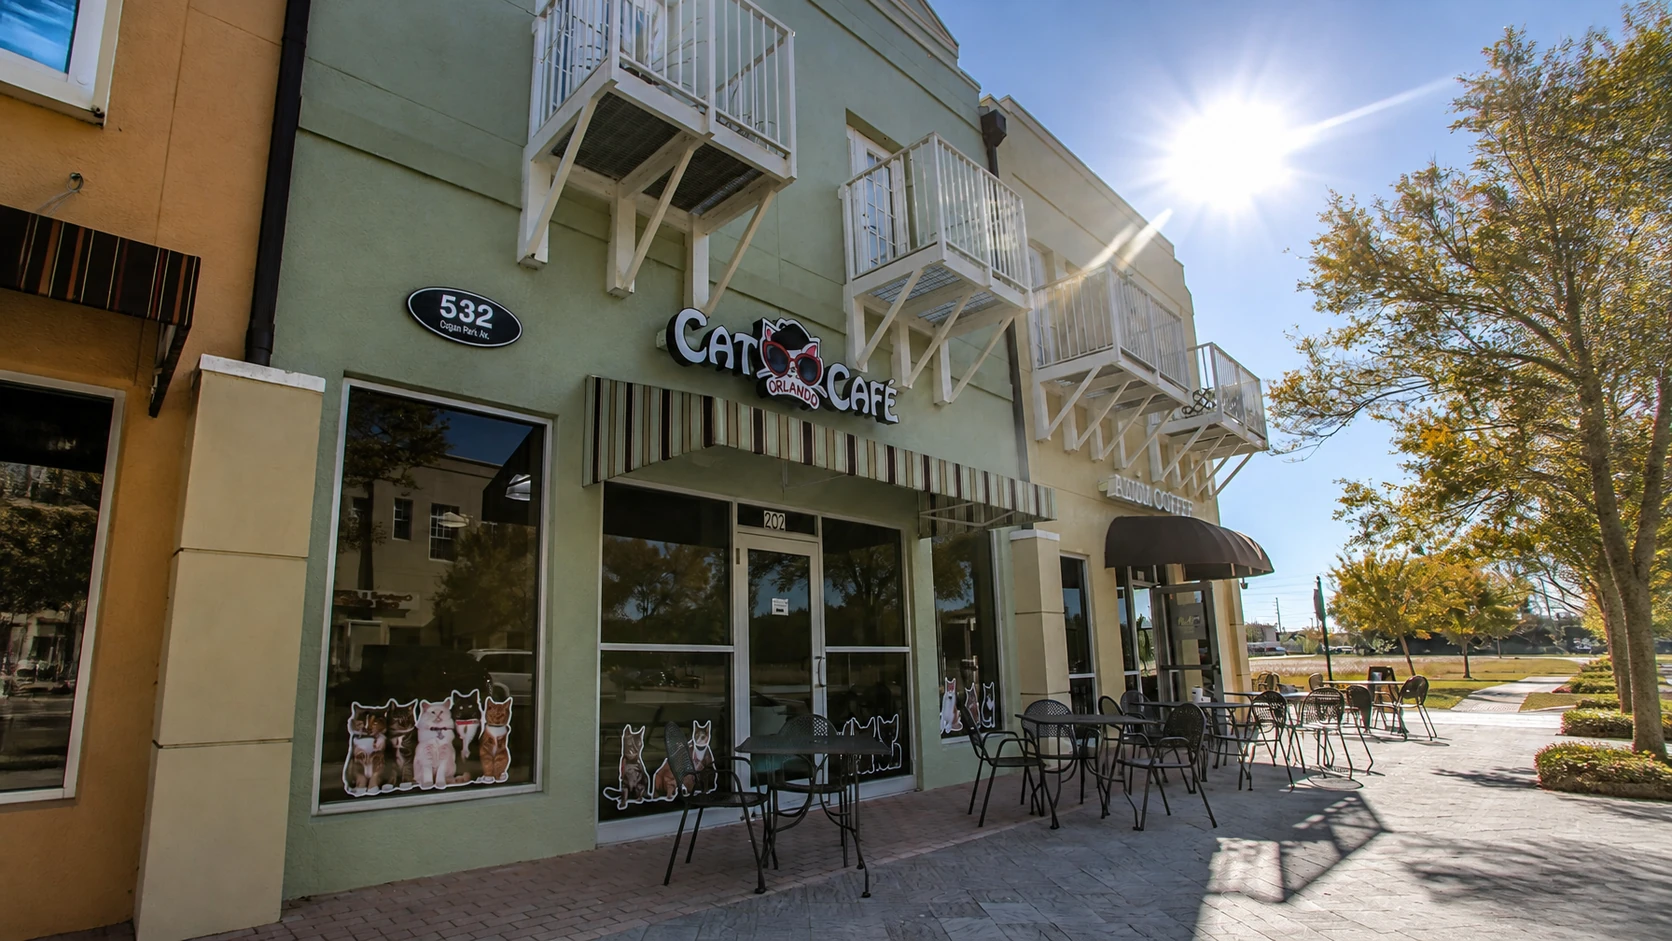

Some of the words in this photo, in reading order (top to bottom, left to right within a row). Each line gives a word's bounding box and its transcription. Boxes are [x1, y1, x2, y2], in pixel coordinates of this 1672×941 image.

[440, 294, 493, 329] 532
[673, 307, 759, 376] CAT
[826, 362, 899, 424] CAFÉ
[768, 379, 819, 408] ORLANDO
[764, 511, 785, 531] 202
